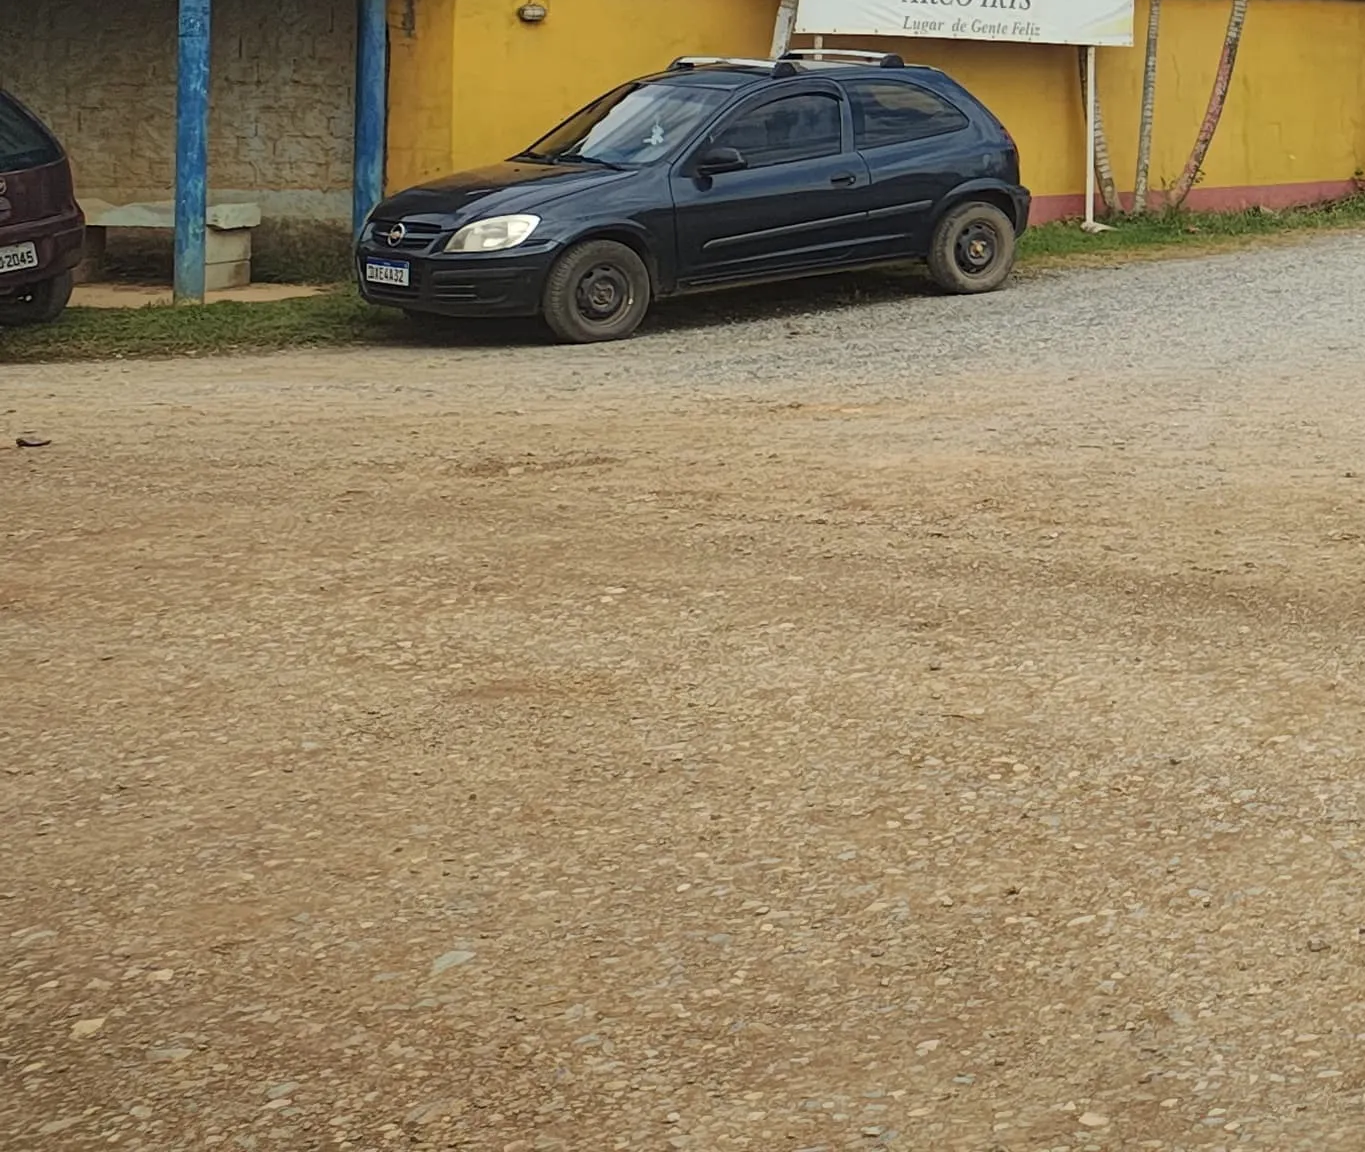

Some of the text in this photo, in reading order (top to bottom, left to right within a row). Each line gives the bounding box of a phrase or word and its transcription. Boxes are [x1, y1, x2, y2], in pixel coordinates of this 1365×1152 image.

[903, 16, 1041, 37] Lugar de Gente Feliz
